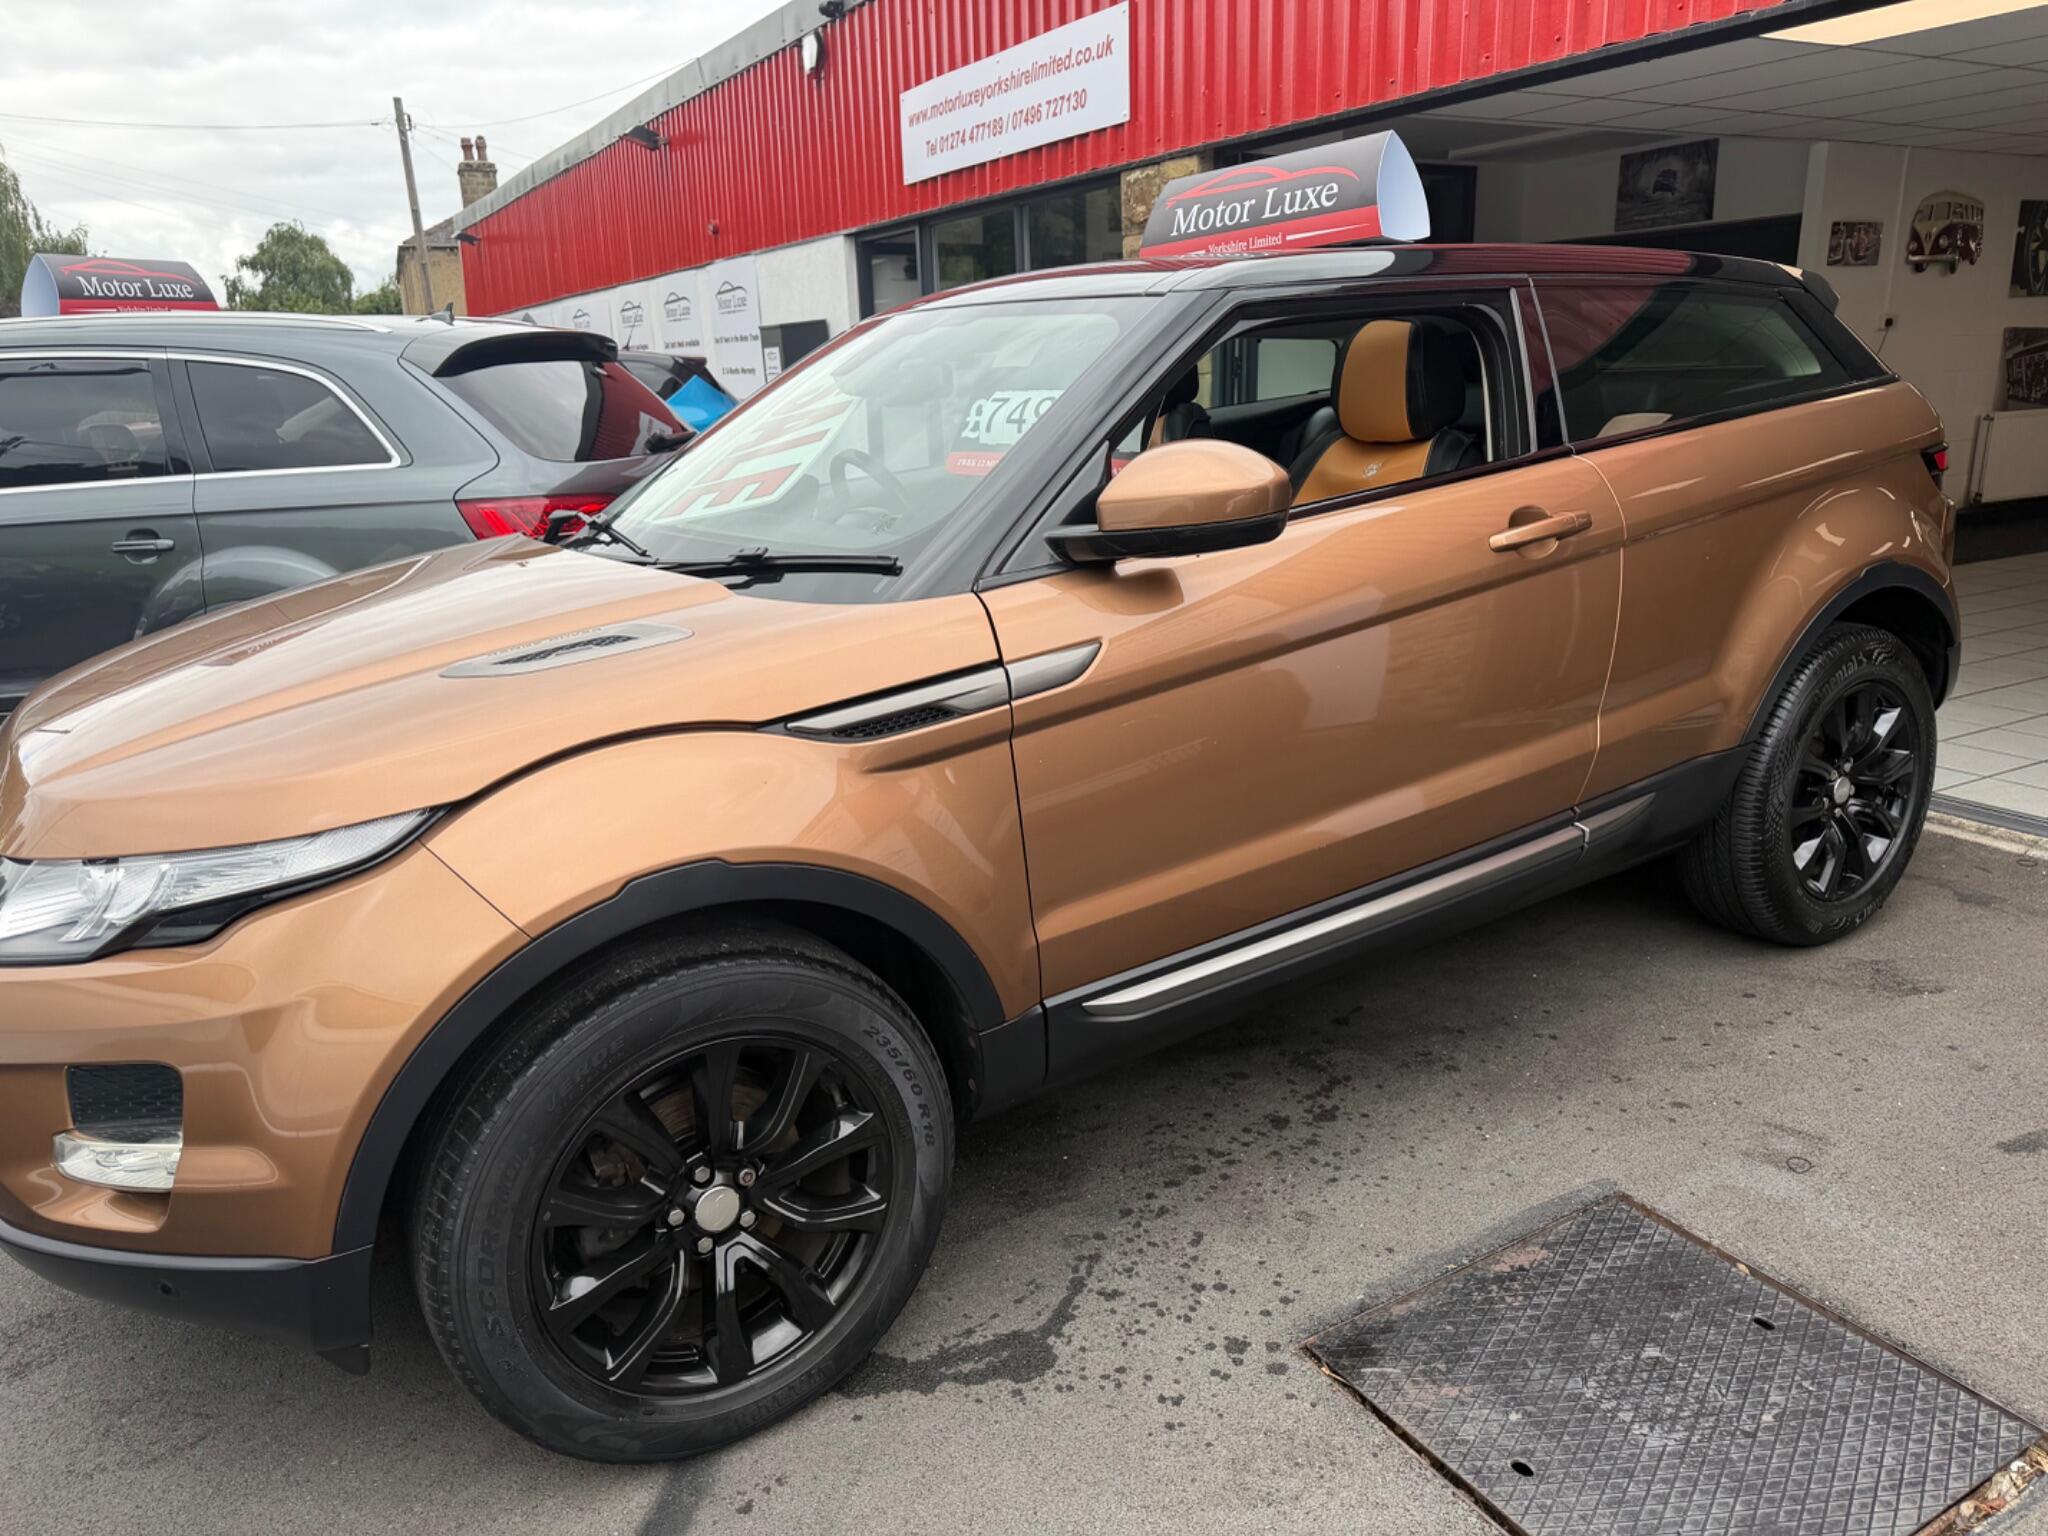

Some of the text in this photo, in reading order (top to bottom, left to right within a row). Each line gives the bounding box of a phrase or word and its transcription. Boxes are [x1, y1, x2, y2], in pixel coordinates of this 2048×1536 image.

[908, 34, 1115, 128] www.motorluxeyorkshirelimited.co.uk
[925, 139, 938, 158] Tel
[939, 131, 966, 154] 01274
[968, 119, 1004, 143] 477189
[1012, 103, 1042, 130] 07496
[1045, 88, 1088, 121] 727130
[1169, 182, 1339, 236] Motor Luxe
[1208, 232, 1283, 254] Yorkshire Limited
[75, 275, 194, 299] Motor Luxe
[862, 1026, 936, 1147] 235/60 R18
